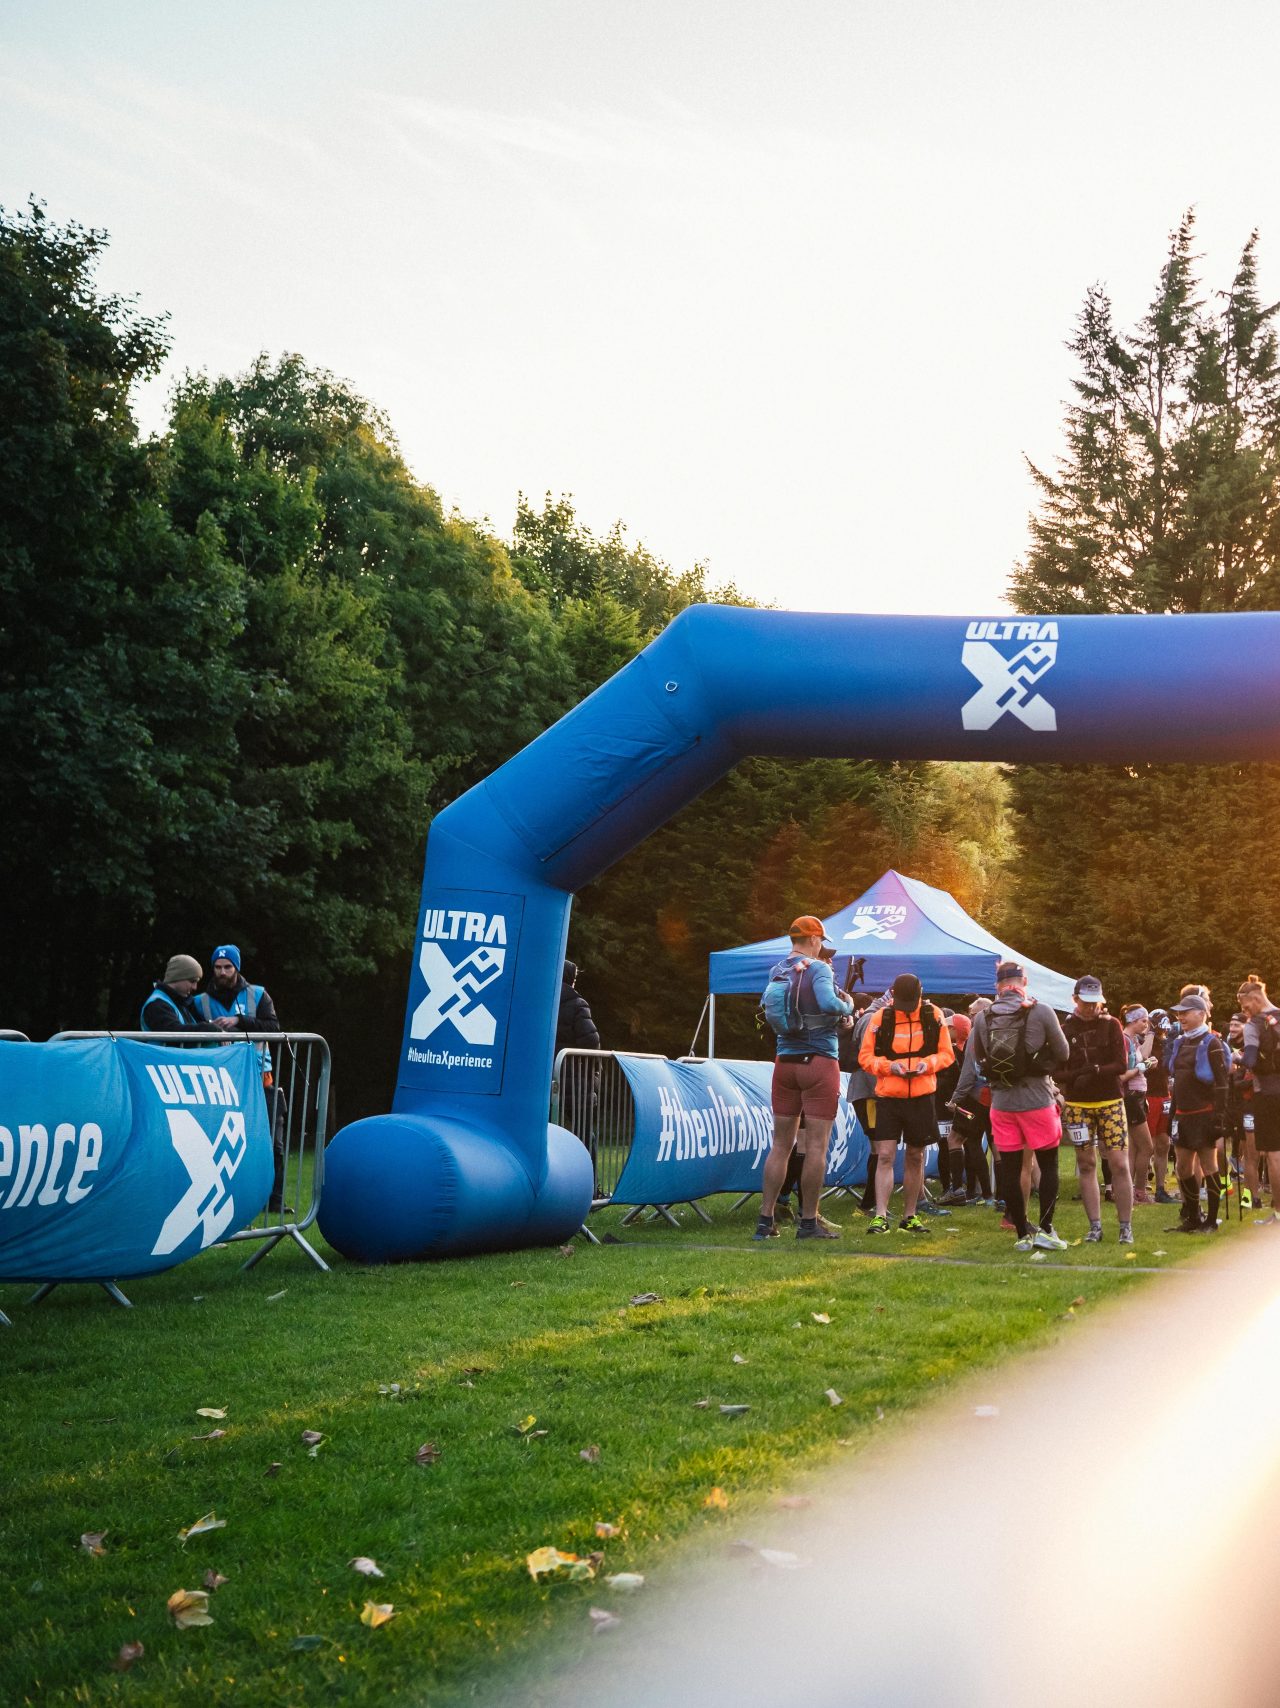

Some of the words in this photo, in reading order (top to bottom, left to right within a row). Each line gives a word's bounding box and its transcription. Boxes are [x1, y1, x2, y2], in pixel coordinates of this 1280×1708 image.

[965, 621, 1059, 640] ULTRA
[856, 905, 907, 916] ULTRA
[423, 909, 507, 945] ULTRA
[407, 1046, 493, 1069] #theultraXperience
[145, 1065, 239, 1106] ULTRA
